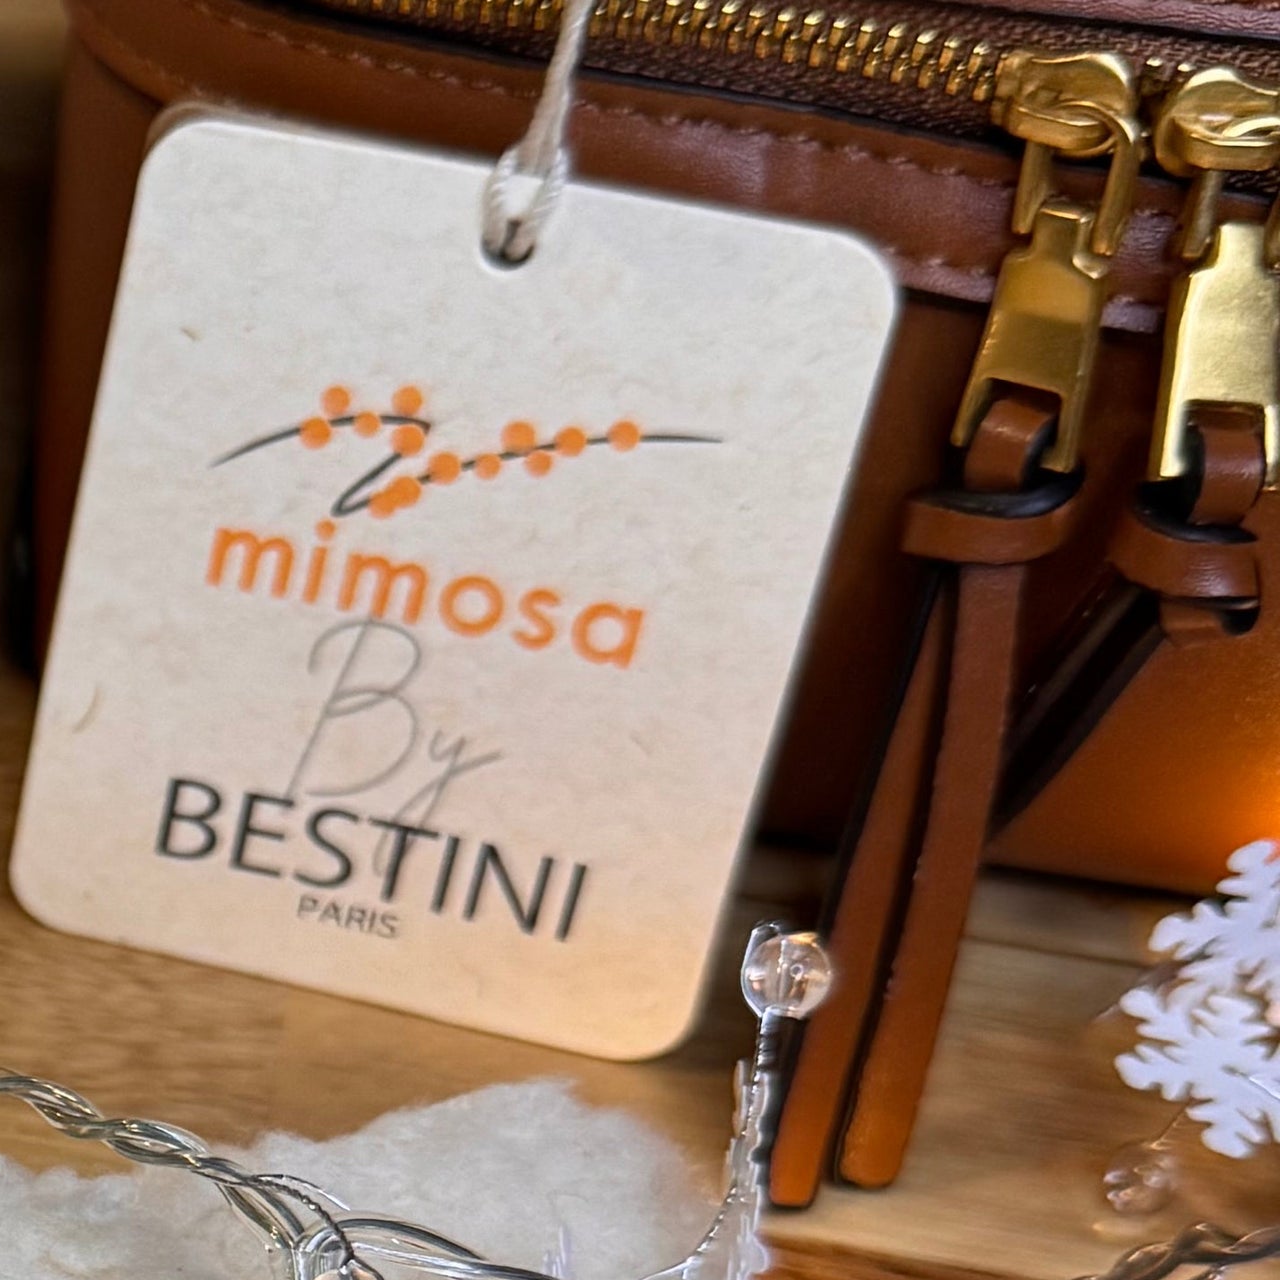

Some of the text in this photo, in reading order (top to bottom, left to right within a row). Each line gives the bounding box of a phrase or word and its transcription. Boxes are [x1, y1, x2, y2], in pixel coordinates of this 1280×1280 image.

[206, 521, 645, 668] mimosa
[282, 617, 504, 878] By
[155, 777, 588, 942] BESTINI
[297, 895, 400, 940] PARIS
